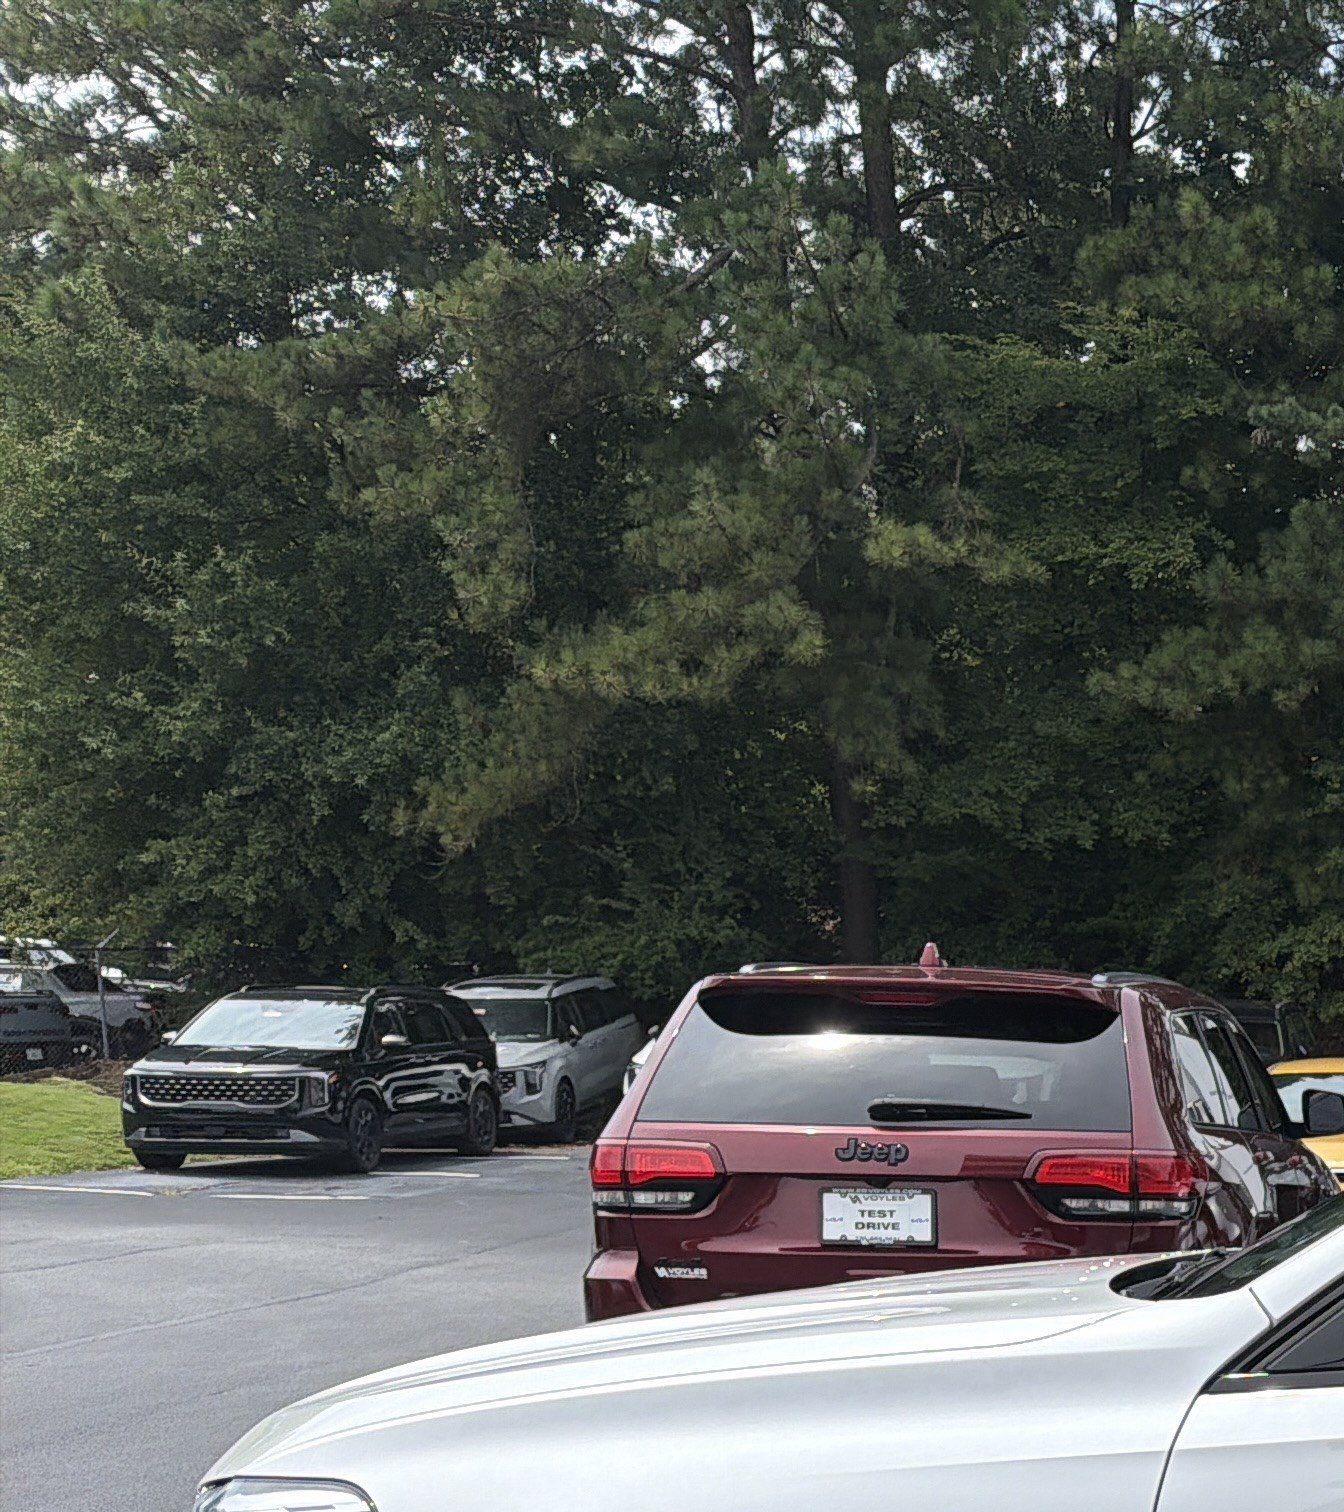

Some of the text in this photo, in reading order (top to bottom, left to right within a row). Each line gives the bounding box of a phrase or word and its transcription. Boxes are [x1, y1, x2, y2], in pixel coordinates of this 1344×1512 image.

[835, 1137, 909, 1167] Jeep
[858, 1209, 896, 1219] TEST
[855, 1221, 900, 1231] DRIVE
